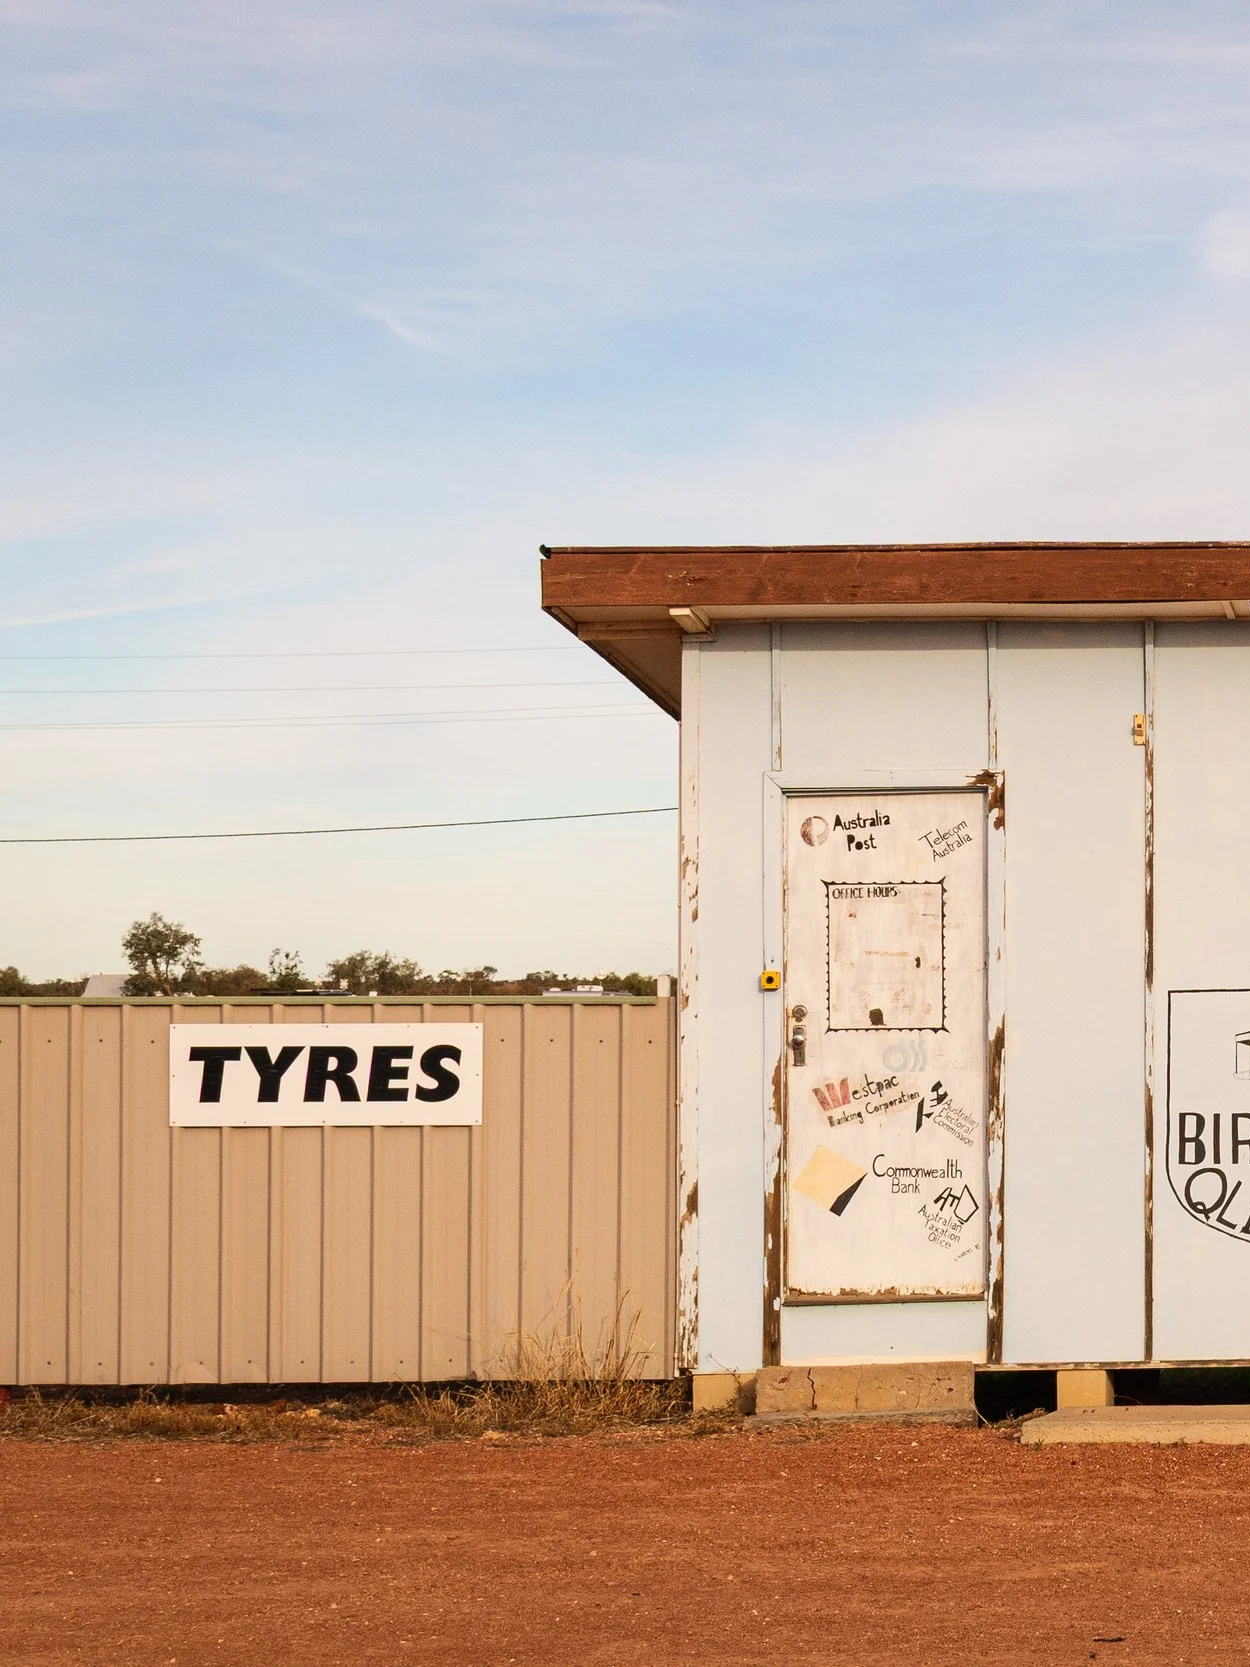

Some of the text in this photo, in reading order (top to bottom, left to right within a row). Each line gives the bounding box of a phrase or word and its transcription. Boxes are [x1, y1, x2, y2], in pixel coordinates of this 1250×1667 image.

[832, 809, 891, 832] Australia
[917, 819, 968, 848] Telecom
[846, 834, 878, 852] Post
[931, 832, 972, 862] Australia
[832, 888, 864, 899] OFFICE
[189, 1044, 462, 1103] TYRES
[812, 1073, 899, 1111] Westpac
[827, 1091, 920, 1127] Banking Corporation
[939, 1107, 975, 1135] Electoral
[942, 1098, 980, 1128] Australian
[933, 1115, 974, 1147] Commission
[872, 1153, 963, 1179] Commonwealth
[891, 1178, 921, 1194] Bank
[917, 1204, 963, 1233] Australian
[924, 1219, 961, 1243] Taxation
